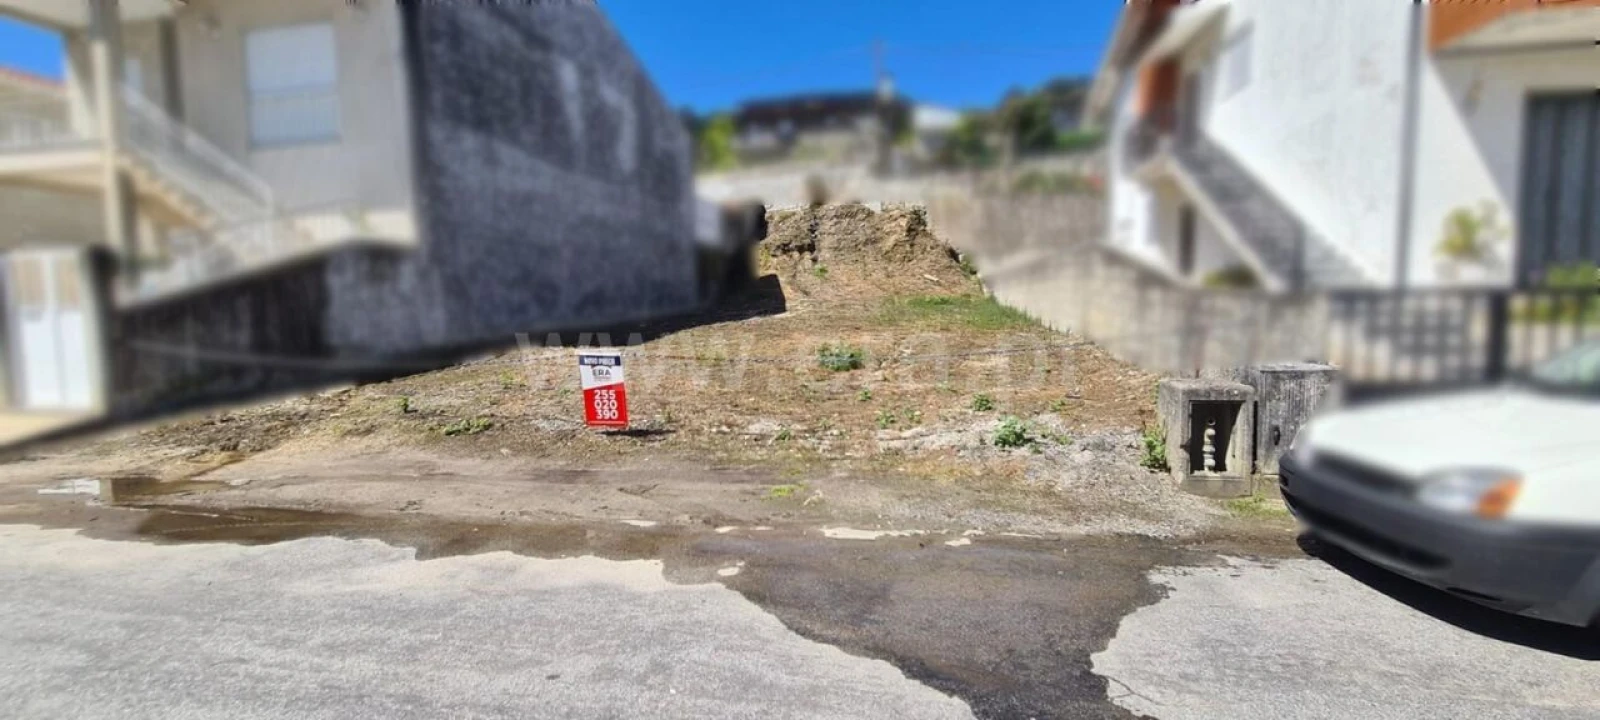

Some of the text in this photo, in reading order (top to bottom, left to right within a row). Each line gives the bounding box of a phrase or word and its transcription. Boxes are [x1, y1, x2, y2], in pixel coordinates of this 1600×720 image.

[592, 369, 611, 377] ERA
[594, 389, 616, 399] 255
[594, 399, 618, 410] 020
[596, 409, 619, 419] 390
